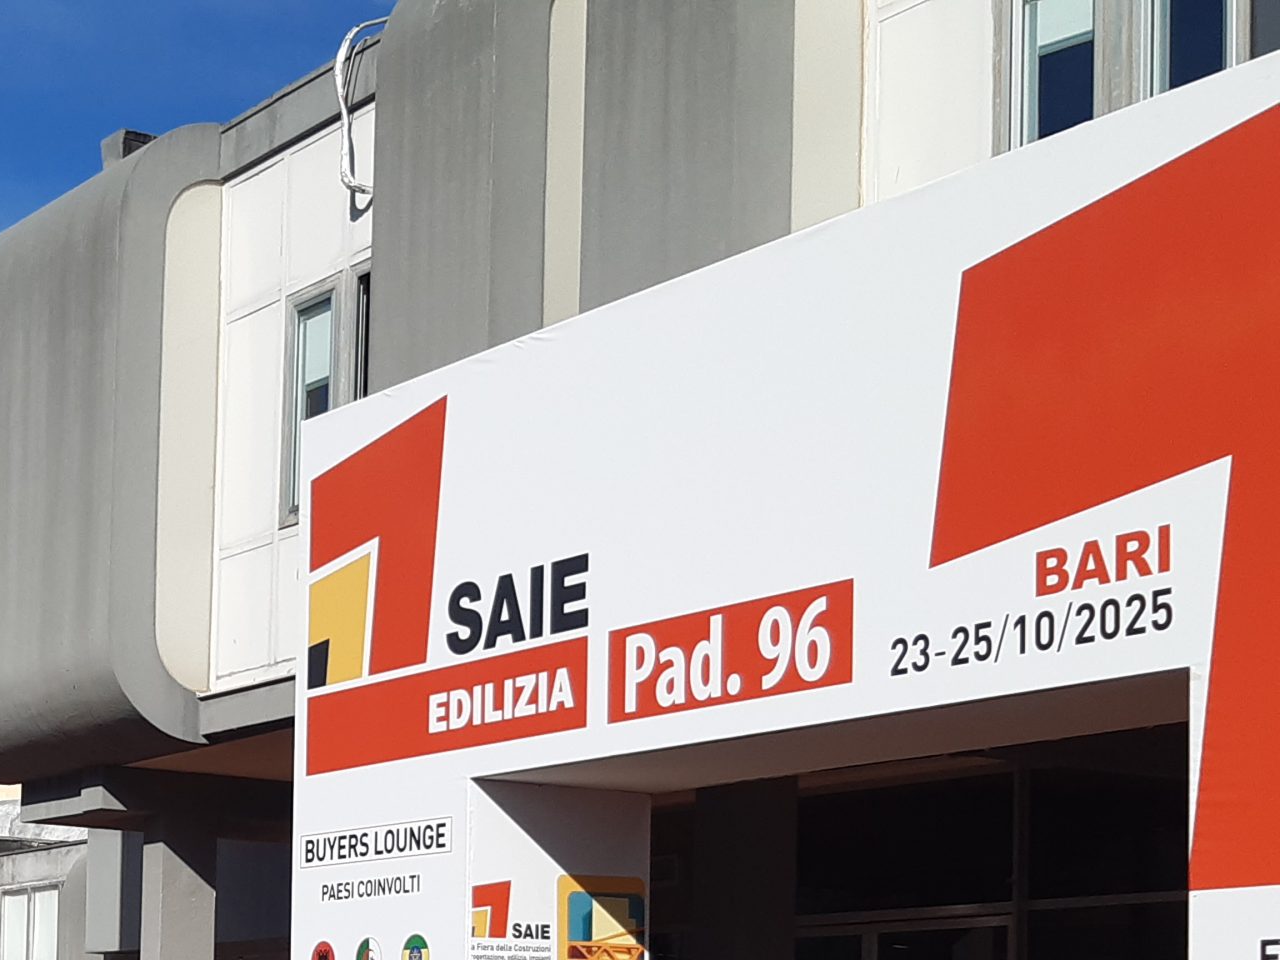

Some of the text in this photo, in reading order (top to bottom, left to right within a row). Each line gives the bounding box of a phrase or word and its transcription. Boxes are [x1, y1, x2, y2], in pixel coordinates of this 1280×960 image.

[1035, 524, 1172, 598] BARI
[446, 552, 590, 656] SAIE
[890, 587, 1174, 679] 23-25/10/2025
[623, 596, 832, 715] Pad. 96
[427, 664, 574, 736] EDILIZIA
[304, 822, 447, 863] BUYERS LOUNGE
[321, 874, 421, 902] PAESI COINVOLTI
[477, 943, 494, 952] Fiera
[496, 943, 512, 952] delle
[513, 943, 552, 953] Costruzioni
[512, 922, 551, 940] SAIE
